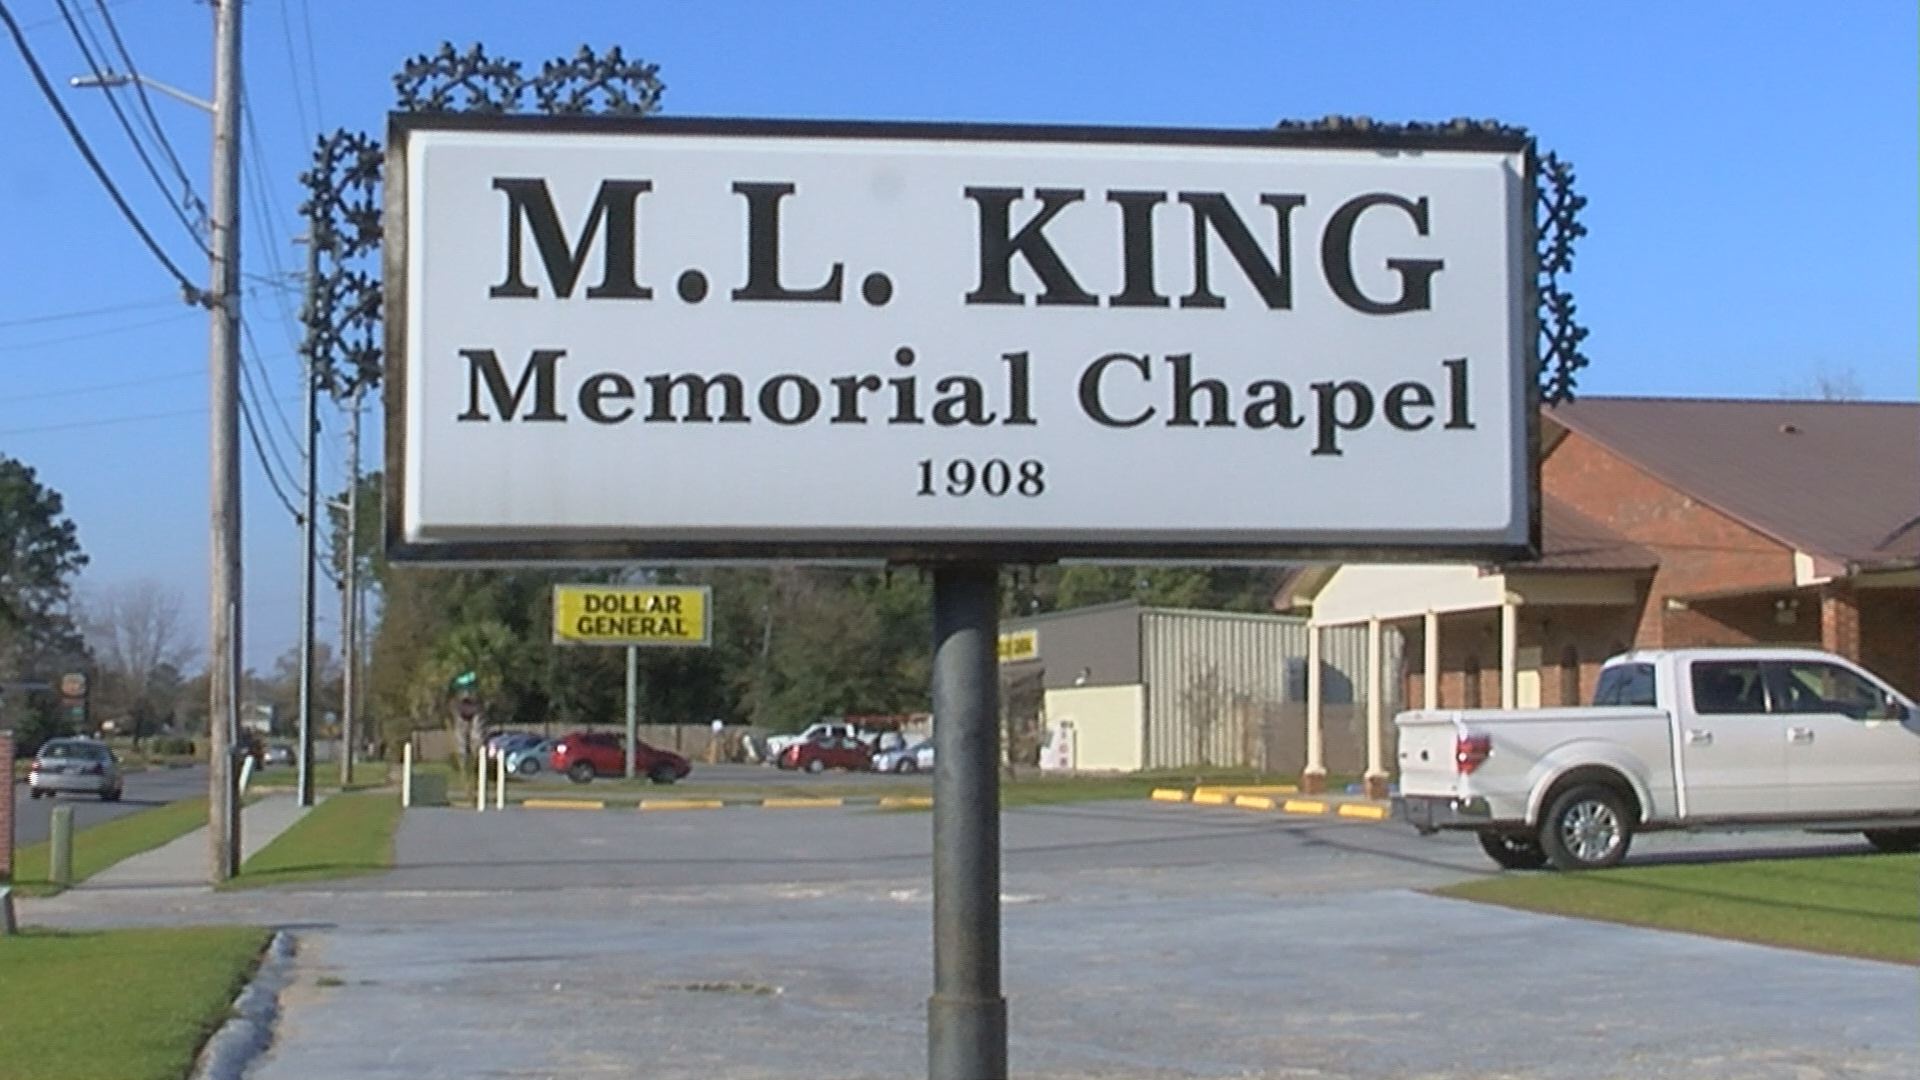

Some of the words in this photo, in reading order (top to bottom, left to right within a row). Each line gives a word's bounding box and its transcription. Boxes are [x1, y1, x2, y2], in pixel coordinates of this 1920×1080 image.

[490, 176, 893, 307] M.L.
[964, 186, 1445, 316] KING
[457, 346, 1038, 426] Memorial
[1078, 352, 1477, 457] Chapel
[916, 458, 1046, 498] 1908
[584, 593, 682, 614] DOLLAR
[577, 616, 689, 636] GENERAL
